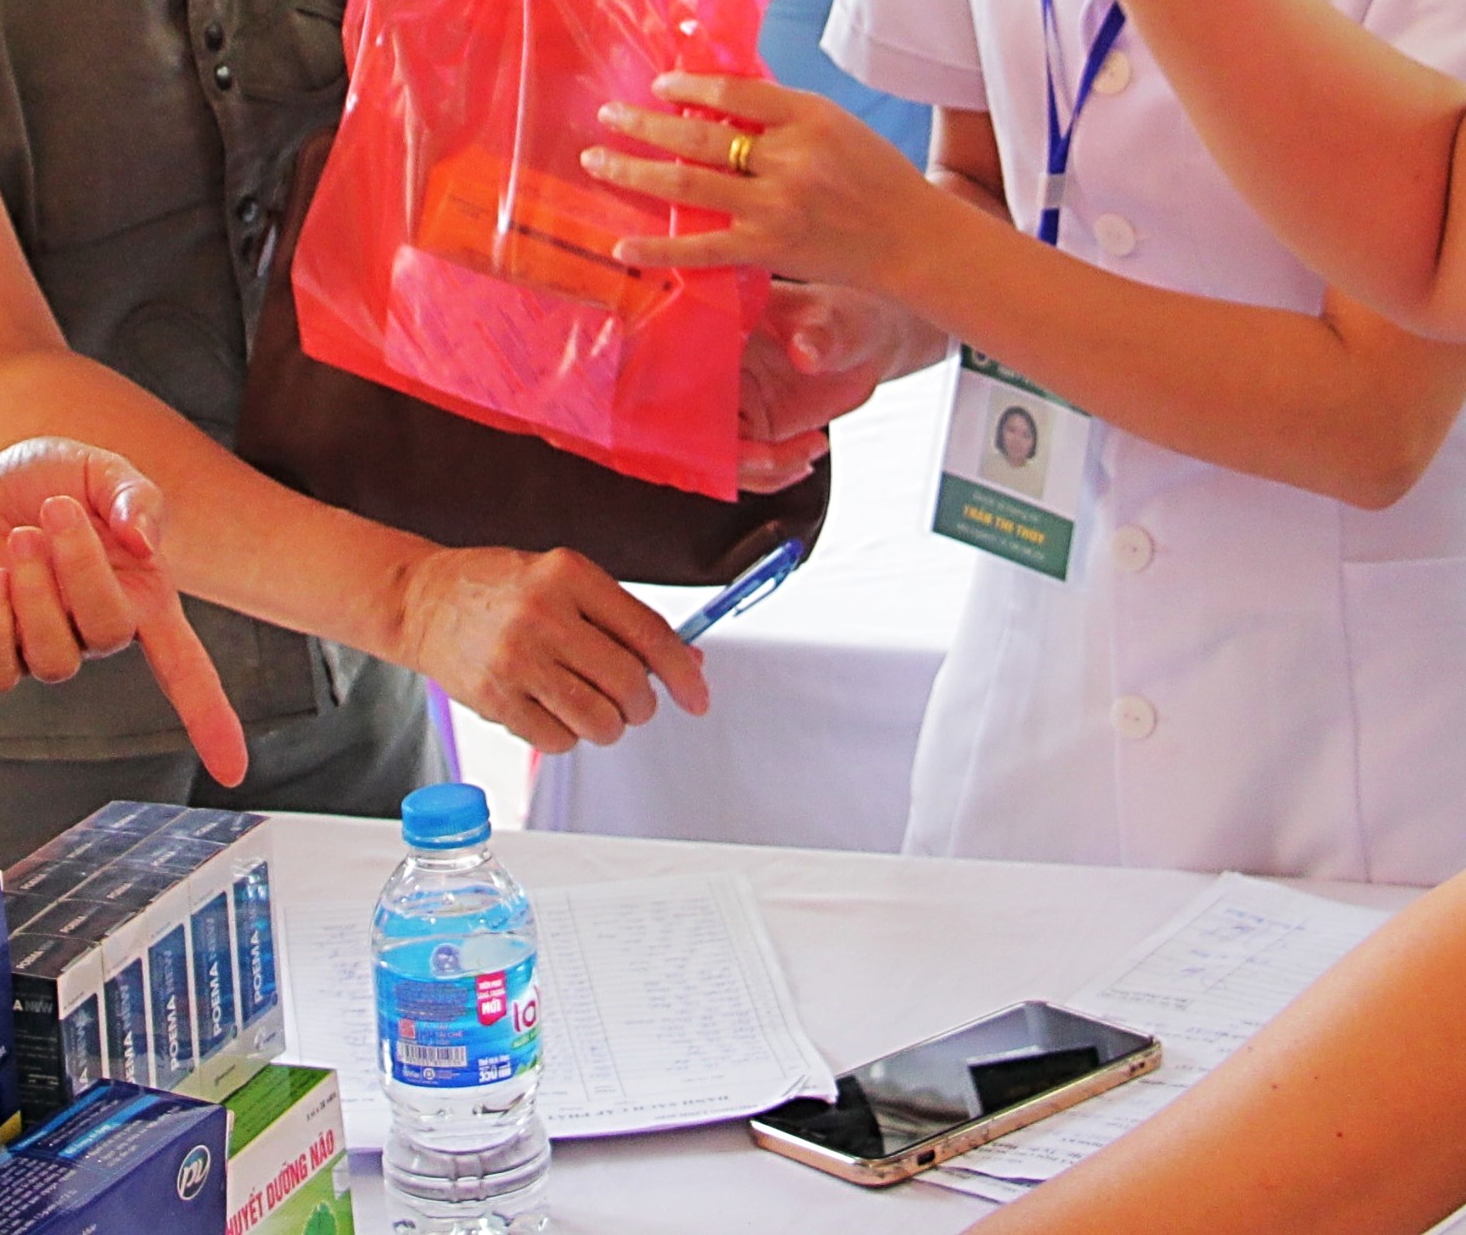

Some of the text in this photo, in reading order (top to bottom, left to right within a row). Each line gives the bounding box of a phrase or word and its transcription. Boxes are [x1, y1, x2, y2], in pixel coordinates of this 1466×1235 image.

[209, 962, 223, 1036] POEMA
[250, 930, 263, 1004] POEMA
[166, 995, 181, 1071] POEMA
[482, 999, 502, 1014] MỚI
[266, 1153, 308, 1210] DƯỠNG
[309, 1129, 335, 1170] NÃO
